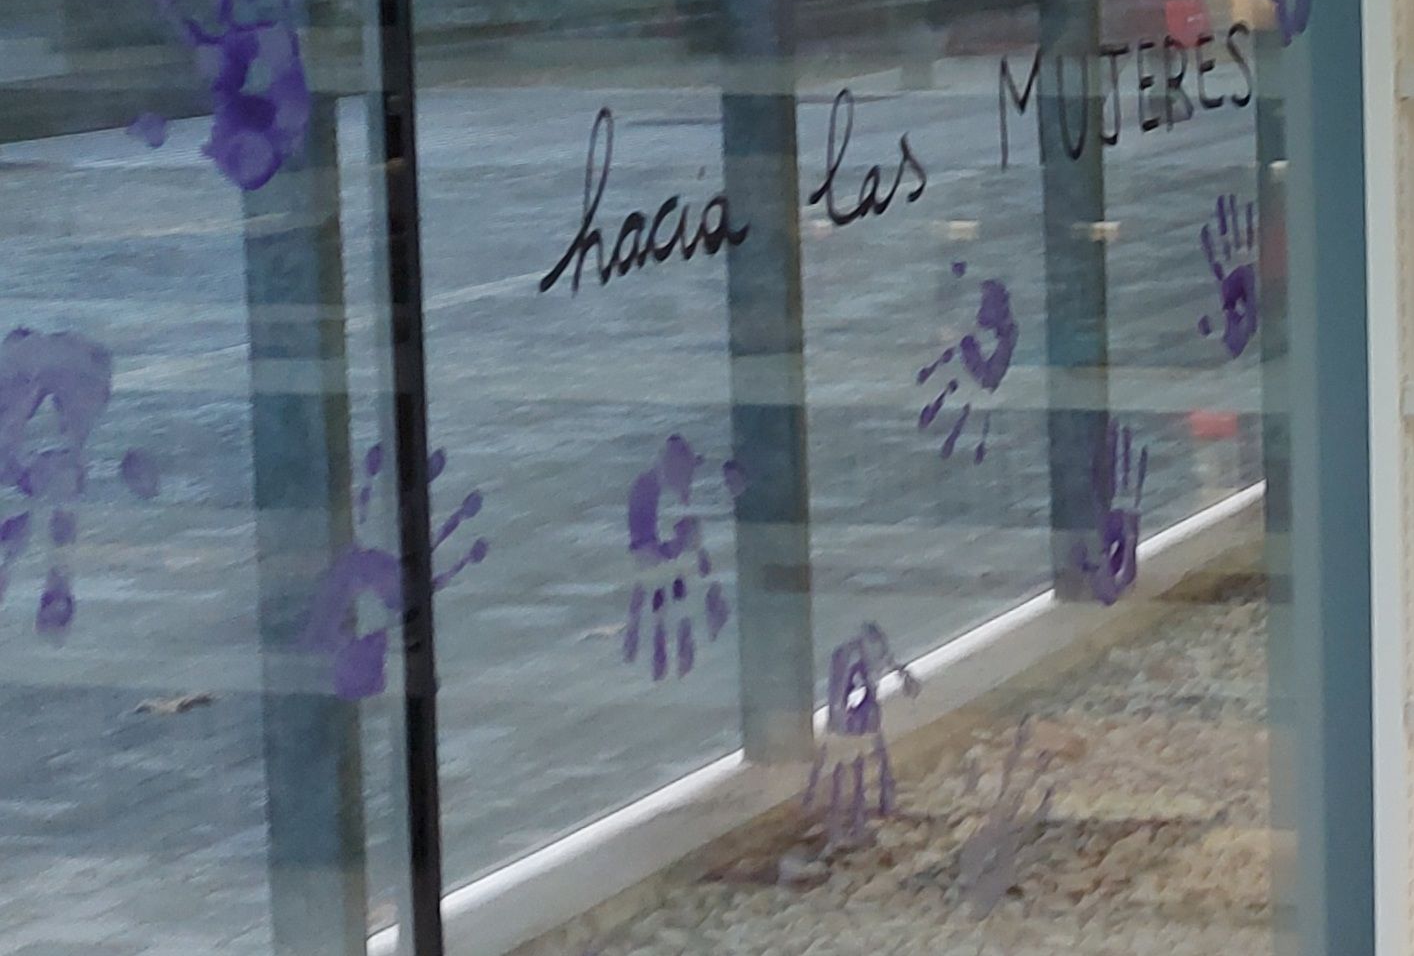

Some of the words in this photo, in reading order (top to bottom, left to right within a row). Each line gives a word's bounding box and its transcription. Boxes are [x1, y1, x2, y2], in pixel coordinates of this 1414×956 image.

[538, 106, 751, 297] hacia
[808, 87, 928, 227] las
[998, 19, 1254, 173] MUJERES
